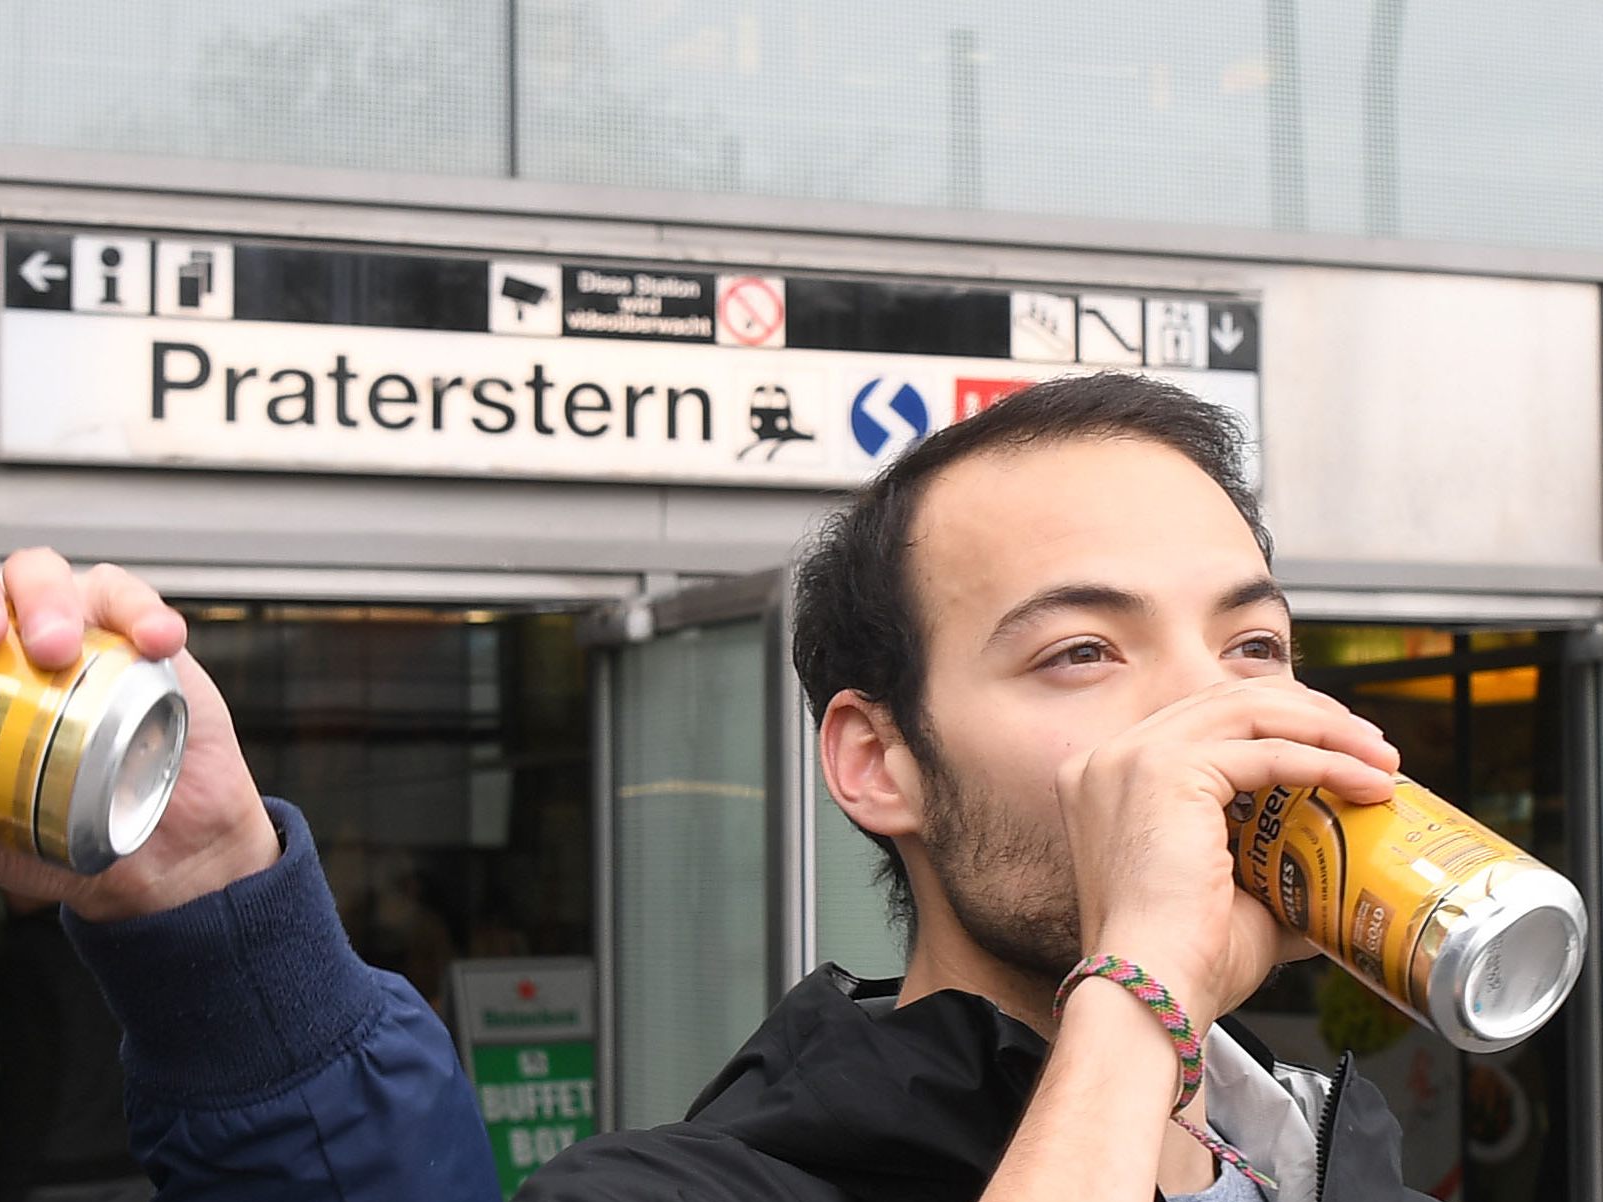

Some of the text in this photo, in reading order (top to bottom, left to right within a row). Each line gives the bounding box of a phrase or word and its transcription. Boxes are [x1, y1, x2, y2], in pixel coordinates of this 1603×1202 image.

[633, 273, 701, 299] Station
[618, 295, 663, 315] wird
[149, 341, 713, 441] Praterstern
[481, 1078, 594, 1123] BUFFET
